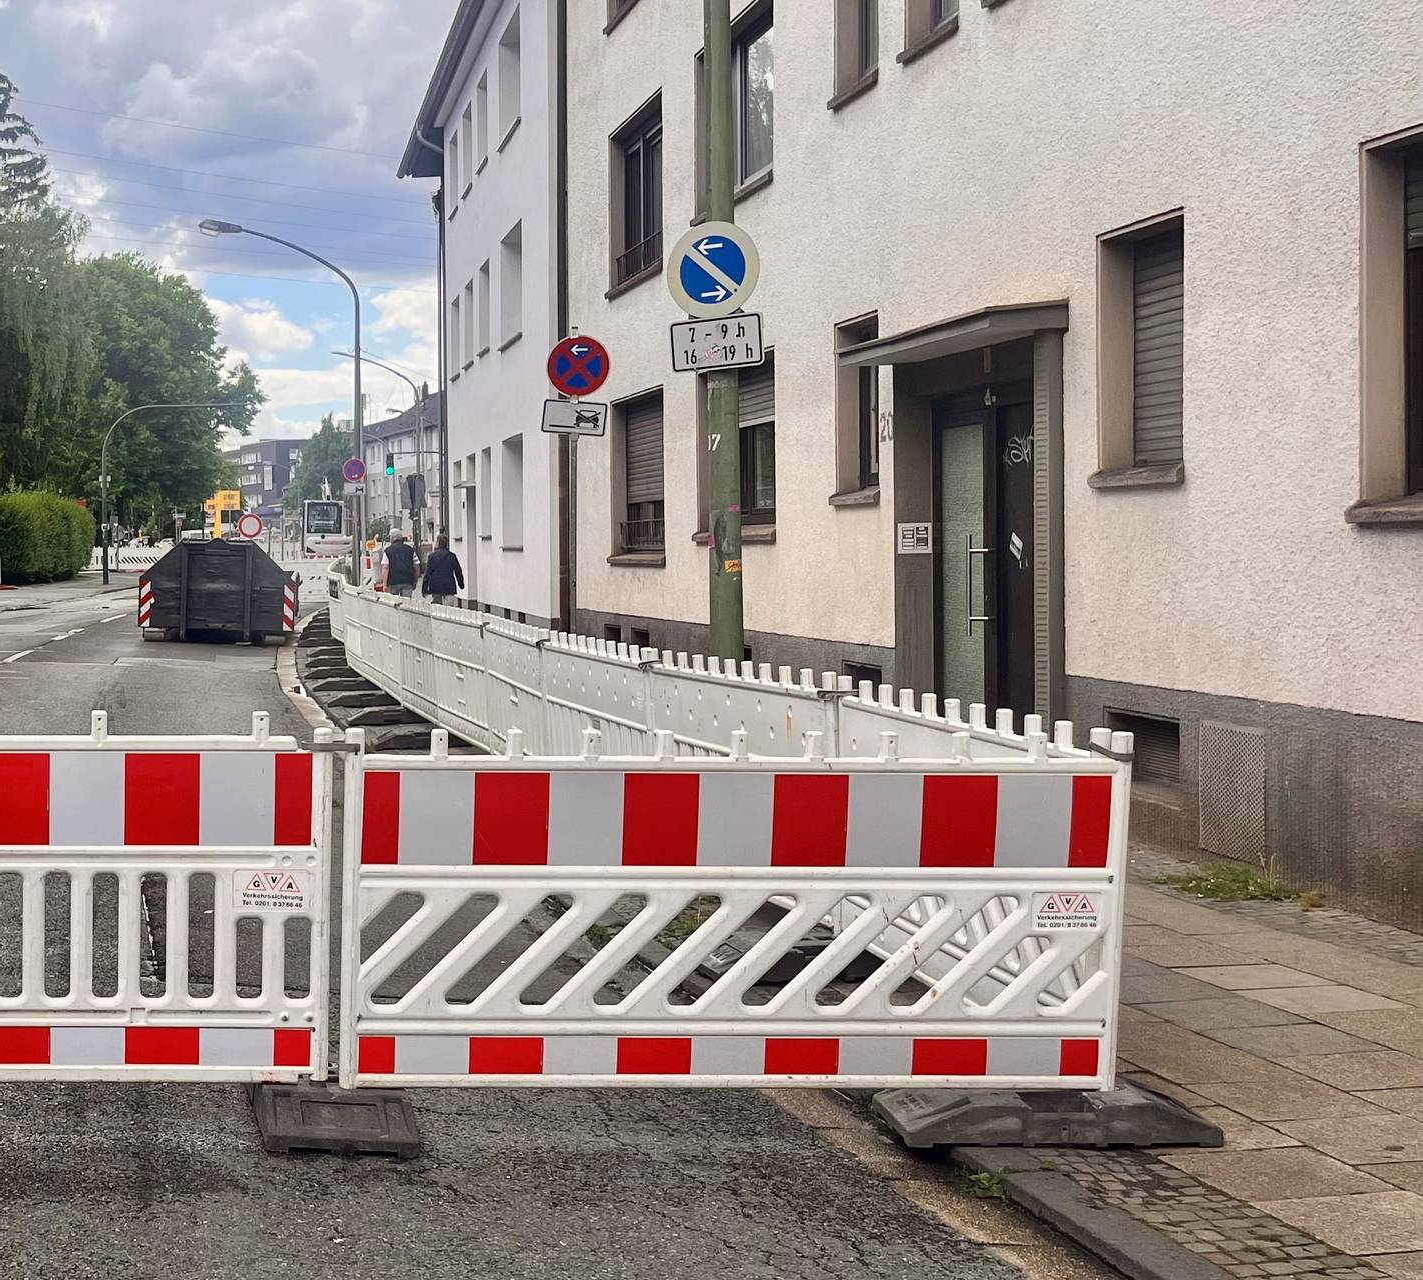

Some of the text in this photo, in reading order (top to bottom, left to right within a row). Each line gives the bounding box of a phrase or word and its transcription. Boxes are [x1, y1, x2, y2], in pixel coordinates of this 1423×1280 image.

[688, 327, 696, 343] 7
[720, 323, 729, 339] 9
[737, 322, 746, 338] h
[683, 348, 697, 365] 16
[722, 345, 736, 361] 19
[745, 343, 753, 359] h
[880, 411, 893, 442] 20
[242, 892, 304, 901] Verkehrssicherung
